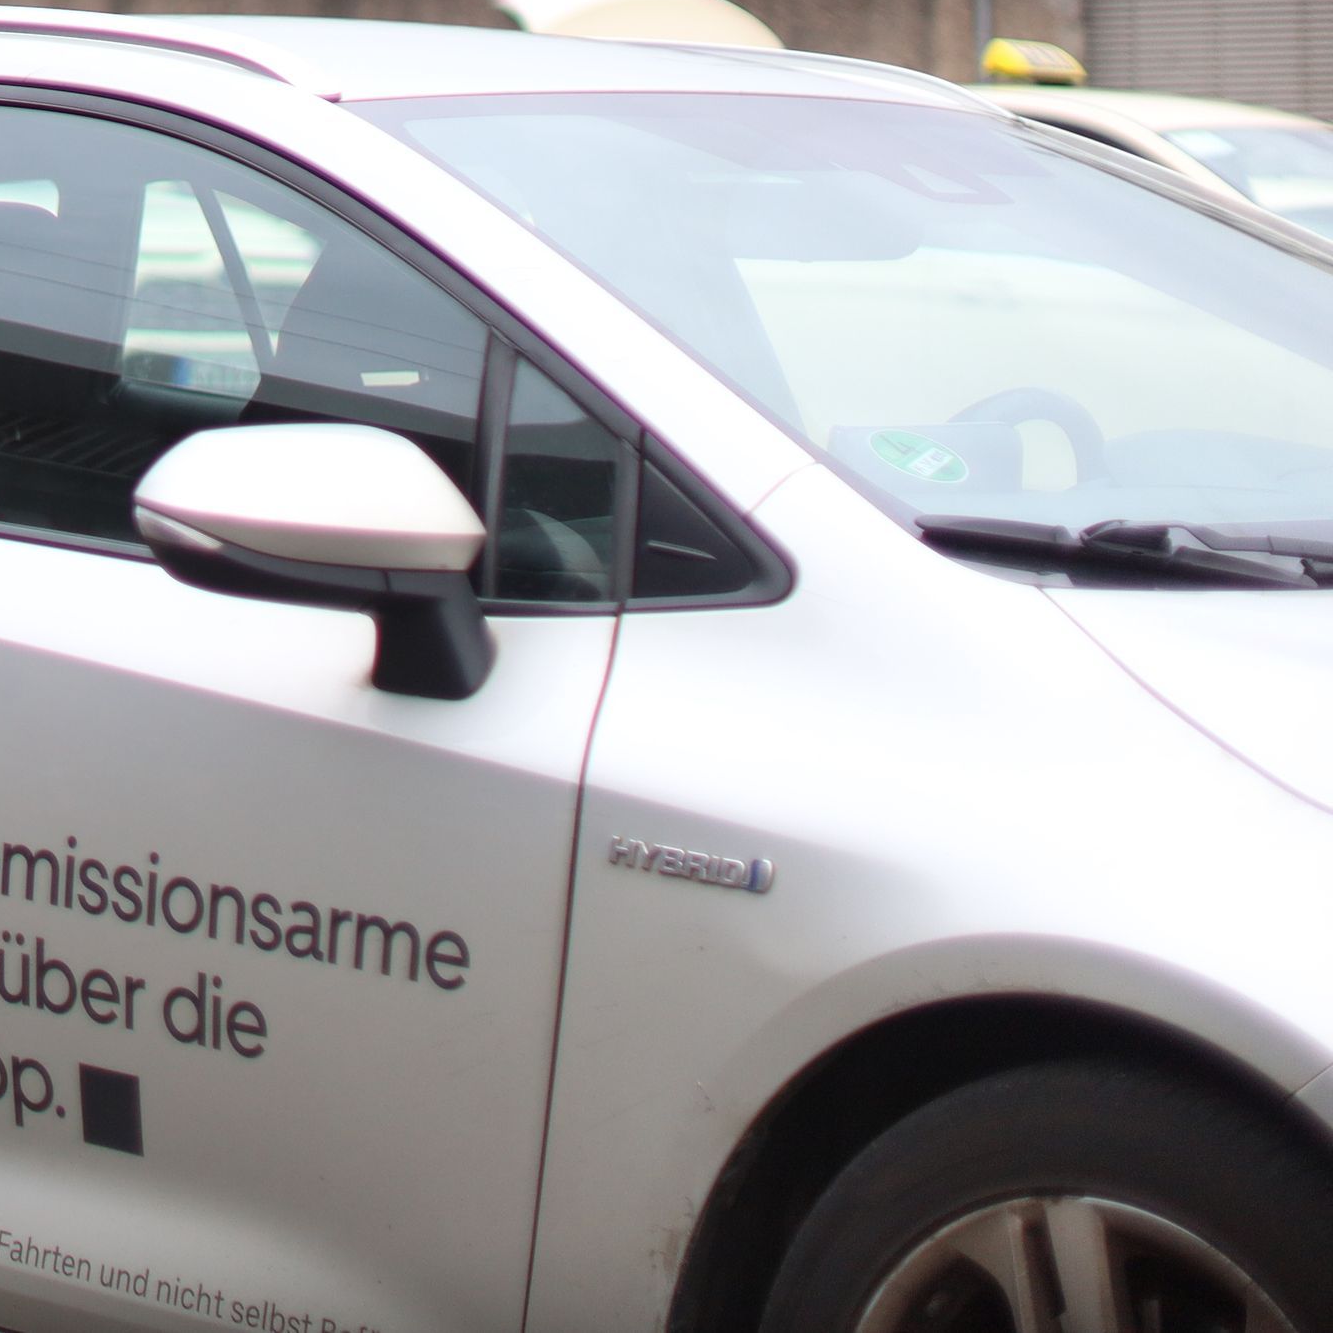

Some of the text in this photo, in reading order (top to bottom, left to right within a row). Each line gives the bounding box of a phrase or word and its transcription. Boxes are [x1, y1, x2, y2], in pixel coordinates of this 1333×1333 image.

[608, 833, 746, 889] HYBRID
[163, 972, 268, 1060] die
[99, 1263, 150, 1298] und
[155, 1277, 225, 1319] nicht
[230, 1300, 313, 1333] selbst
